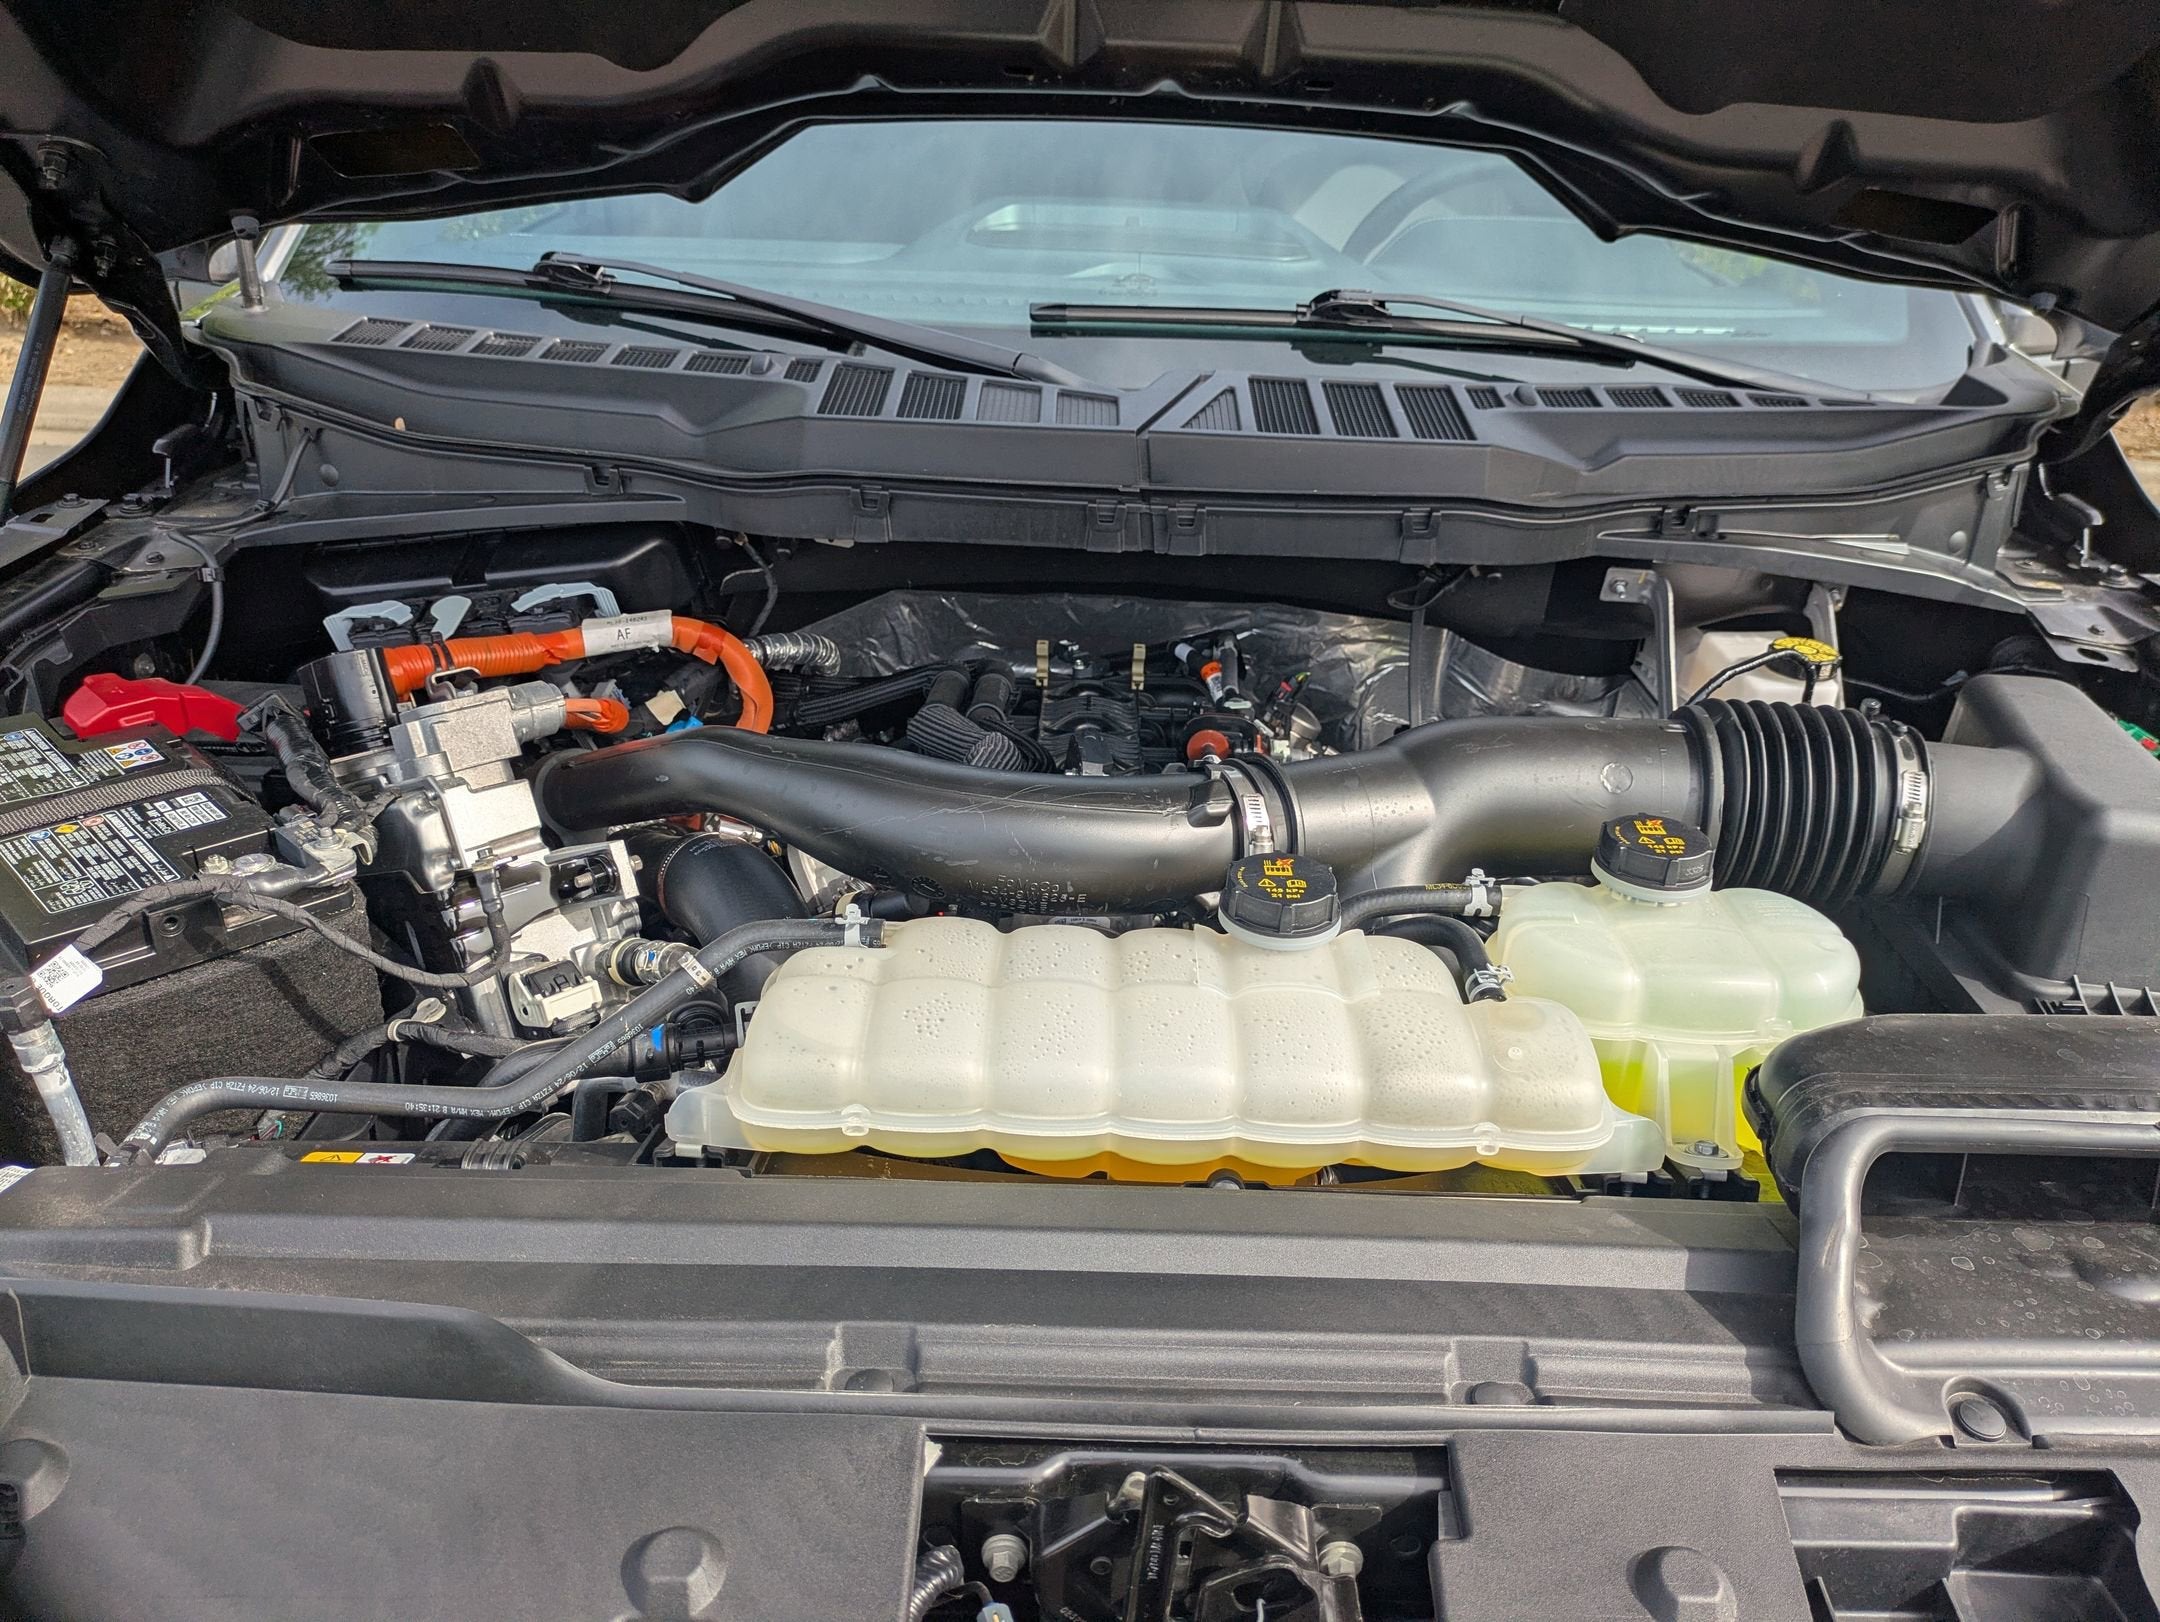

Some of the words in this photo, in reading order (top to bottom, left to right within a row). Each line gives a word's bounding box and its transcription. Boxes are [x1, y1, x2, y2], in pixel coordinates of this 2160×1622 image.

[617, 628, 631, 641] AF
[617, 1023, 644, 1045] 1036865
[554, 1062, 588, 1087] 12/06/24
[309, 1090, 338, 1103] 1036865
[404, 1101, 441, 1113] 21:35:40
